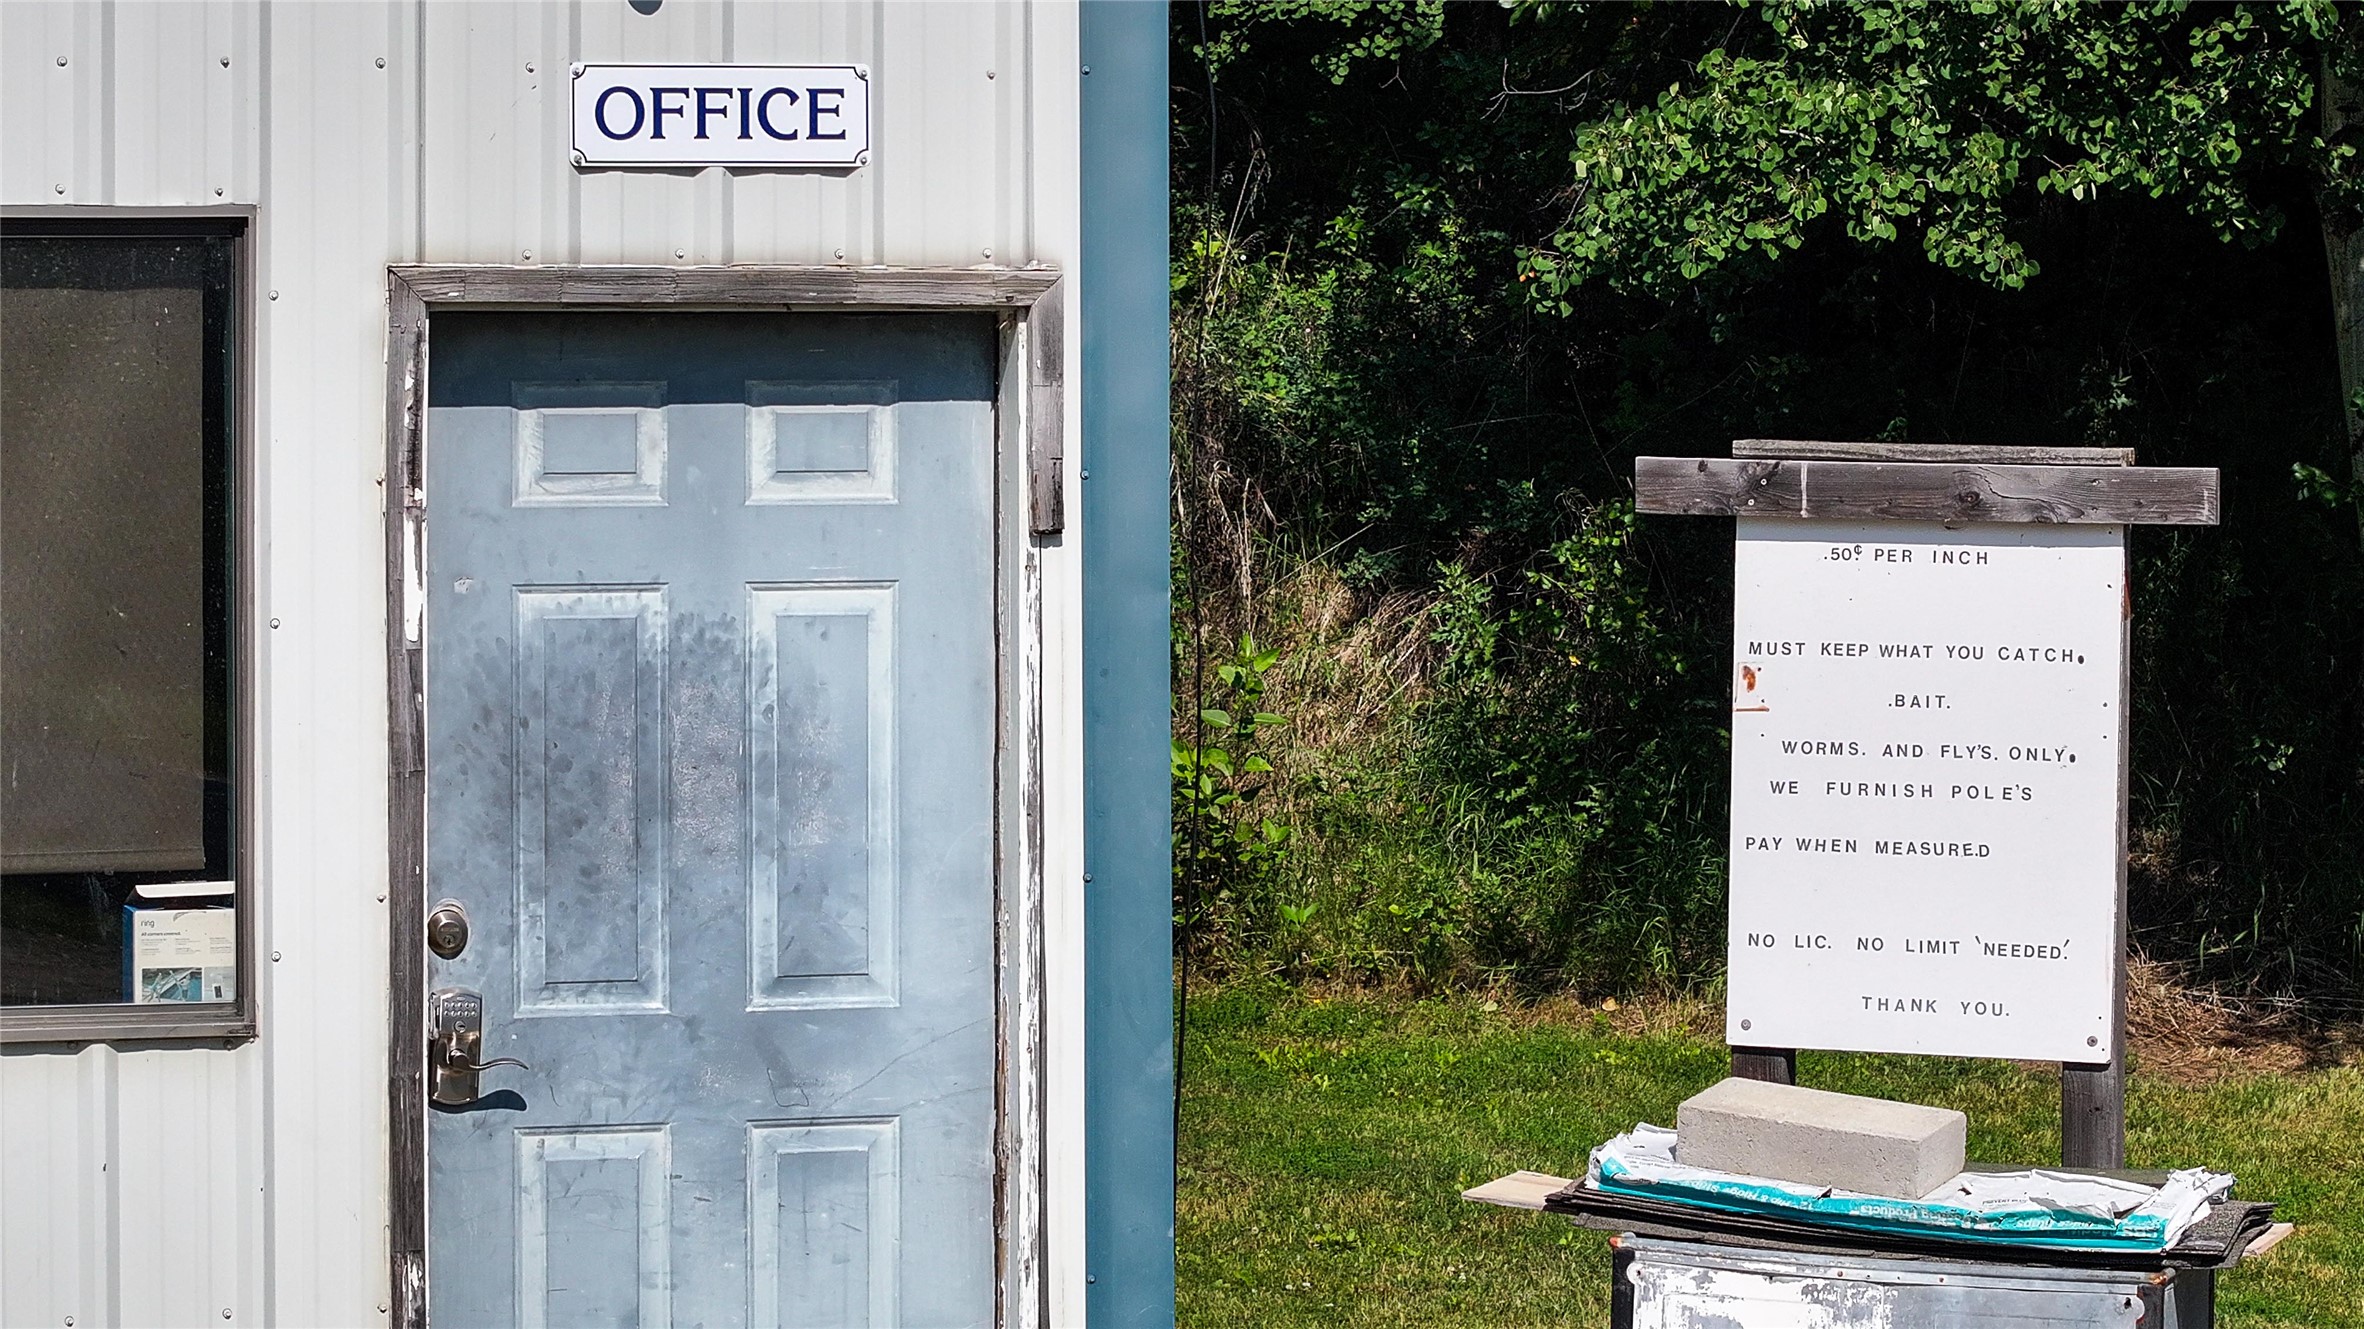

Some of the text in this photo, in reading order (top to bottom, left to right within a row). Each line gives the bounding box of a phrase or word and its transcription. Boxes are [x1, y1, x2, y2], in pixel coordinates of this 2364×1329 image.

[594, 85, 847, 141] OFFICE
[1874, 548, 1913, 563] PER
[1932, 550, 1988, 565] INCH
[1748, 641, 2085, 665] MUST KEEP WHAT YOU CATCH.
[1888, 693, 1951, 709] .BAIT.
[1781, 740, 1866, 756] WORMS.
[1882, 743, 1924, 758] AND
[1940, 744, 1999, 761] FLY'S.
[1769, 780, 2032, 801] WE FURNISH POLE'S
[1745, 836, 1783, 851] PAY
[1795, 837, 1857, 853] WHEN
[140, 920, 155, 928] ring
[1748, 932, 1775, 948] NO
[1794, 934, 1832, 949] LIC.
[1857, 936, 1884, 952] NO
[1905, 938, 1960, 955] LIMIT
[1861, 996, 2010, 1017] THANK YOU.
